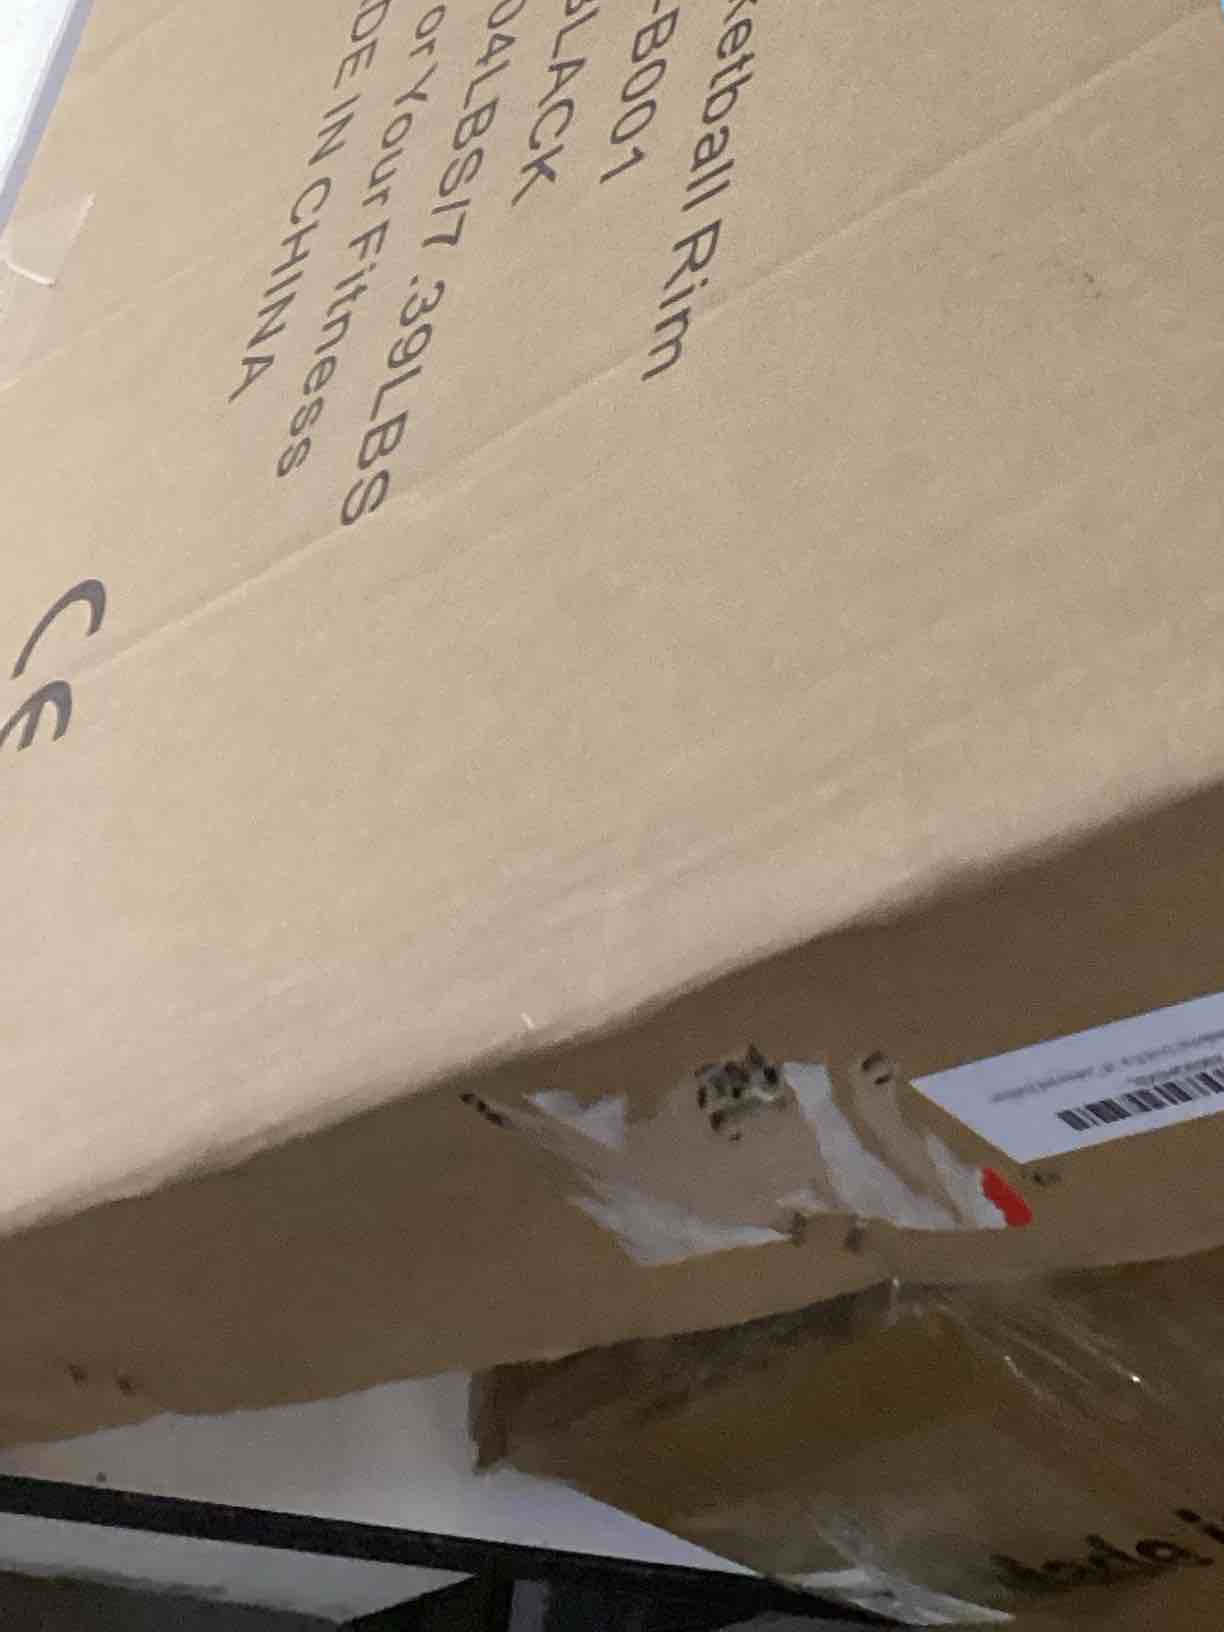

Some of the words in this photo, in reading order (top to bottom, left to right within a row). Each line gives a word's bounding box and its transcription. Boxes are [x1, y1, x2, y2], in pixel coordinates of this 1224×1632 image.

[308, 94, 361, 166] IN
[361, 63, 438, 207] Your
[227, 176, 332, 404] CHINA
[276, 219, 390, 478] Fitness
[641, 218, 723, 382] Rim
